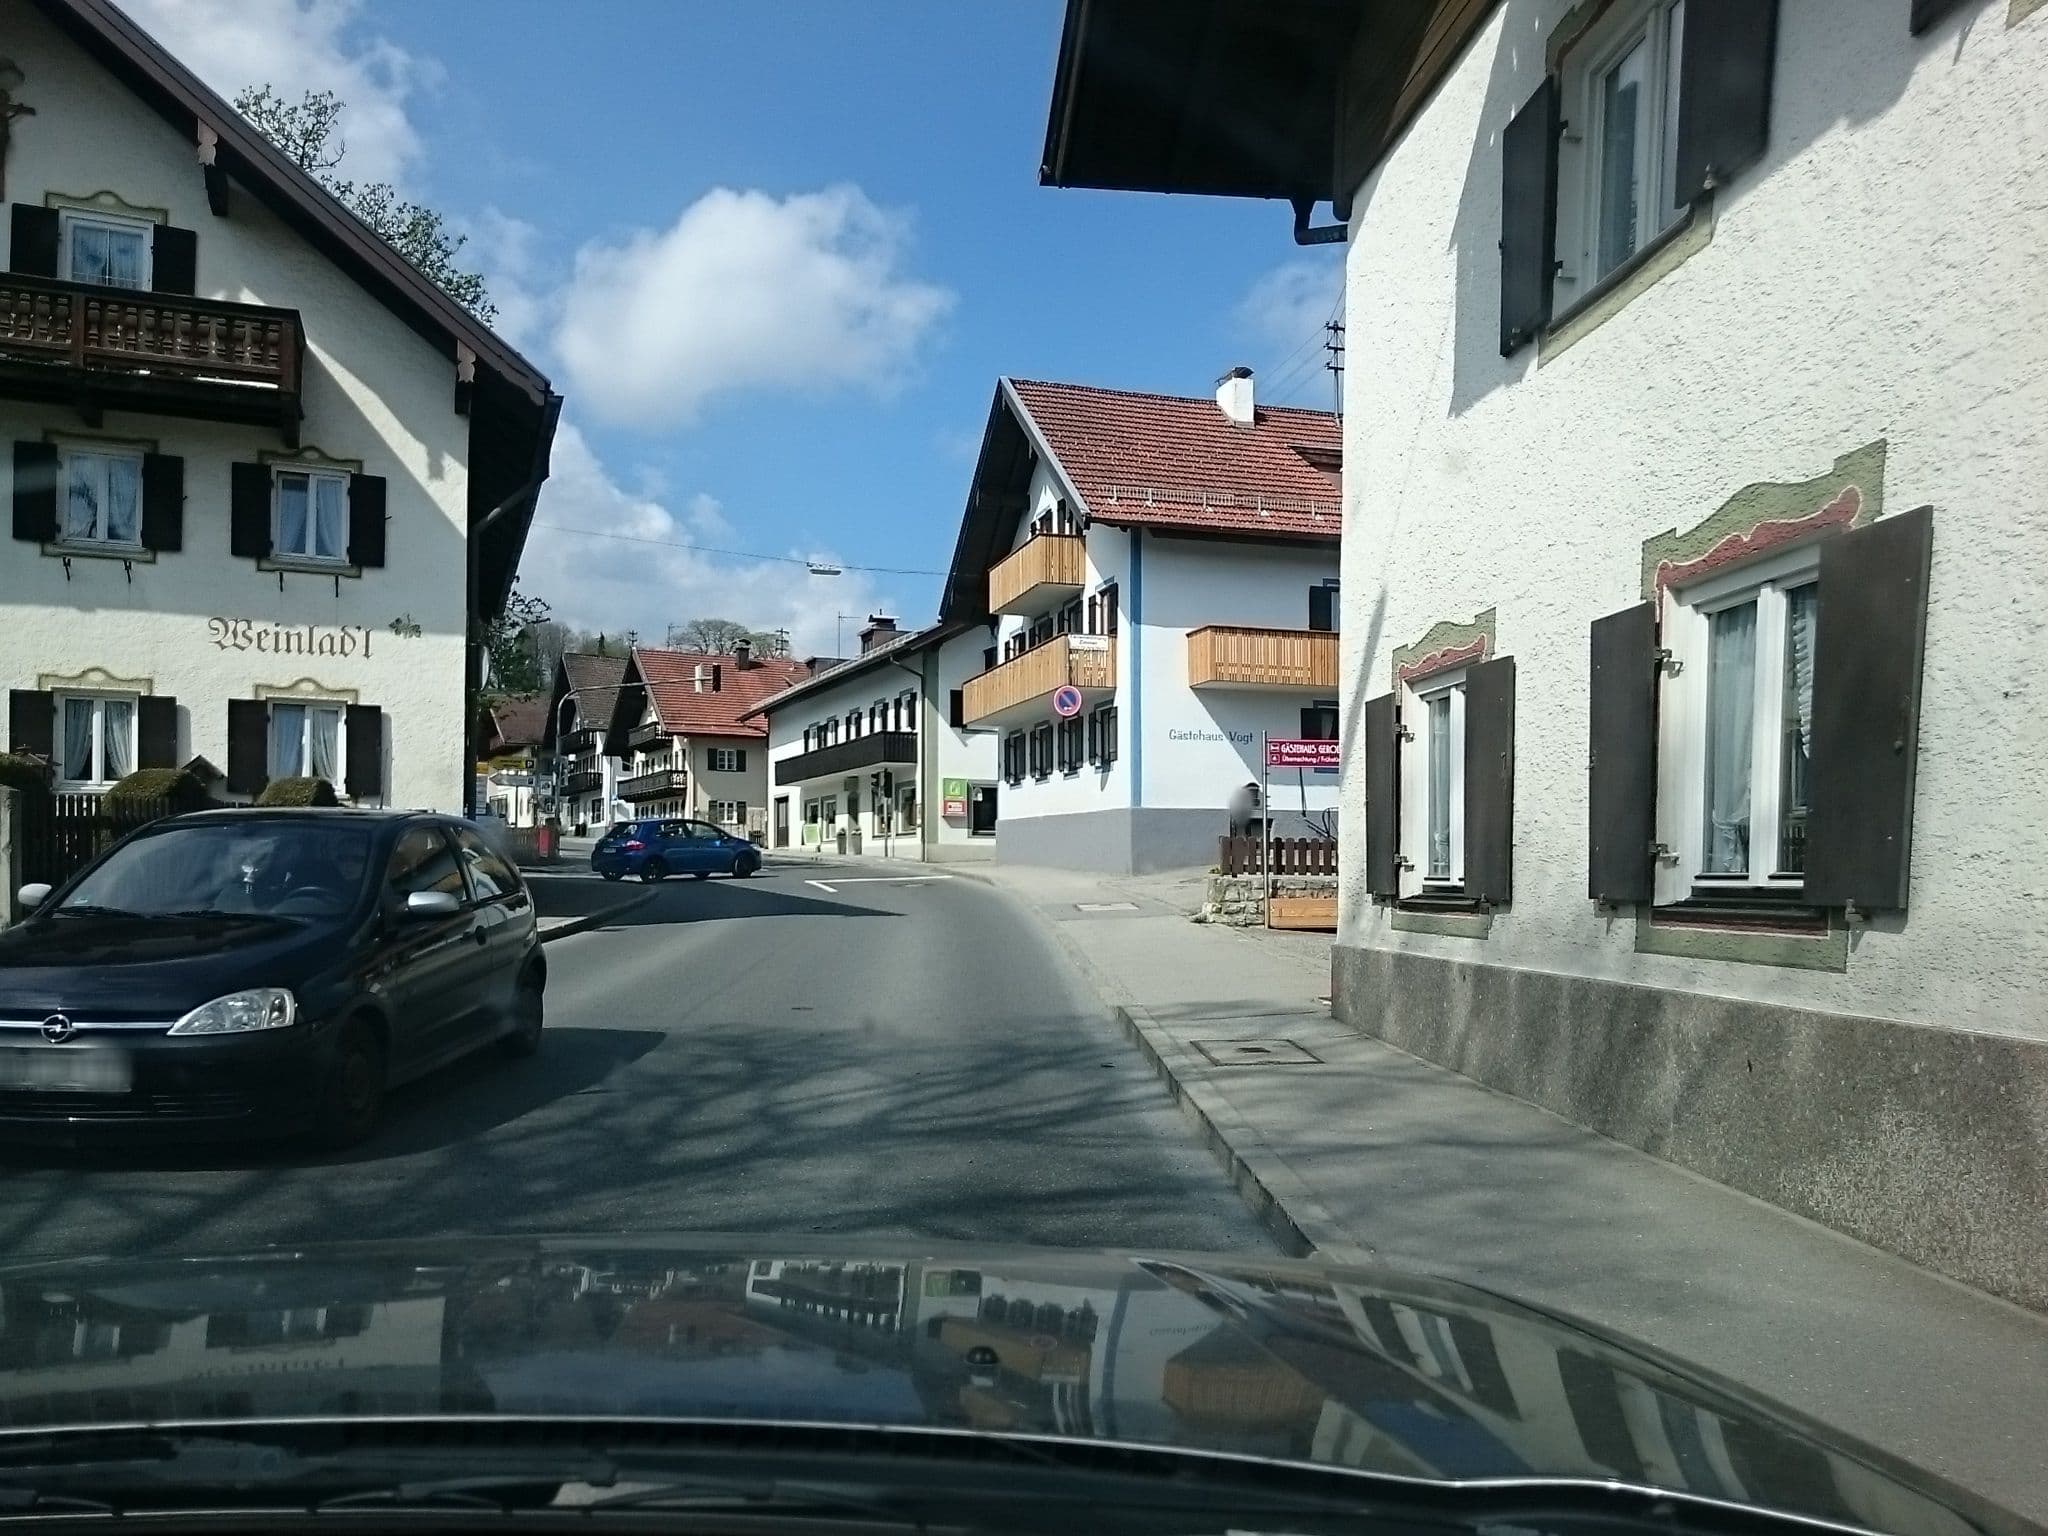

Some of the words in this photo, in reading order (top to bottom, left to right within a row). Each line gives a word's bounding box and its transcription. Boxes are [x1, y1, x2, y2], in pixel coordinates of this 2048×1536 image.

[208, 617, 374, 660] Weinlad'l
[1169, 729, 1223, 742] Gästehaus
[1229, 731, 1253, 745] Vogt
[1281, 743, 1317, 754] GÄSTEHAUS
